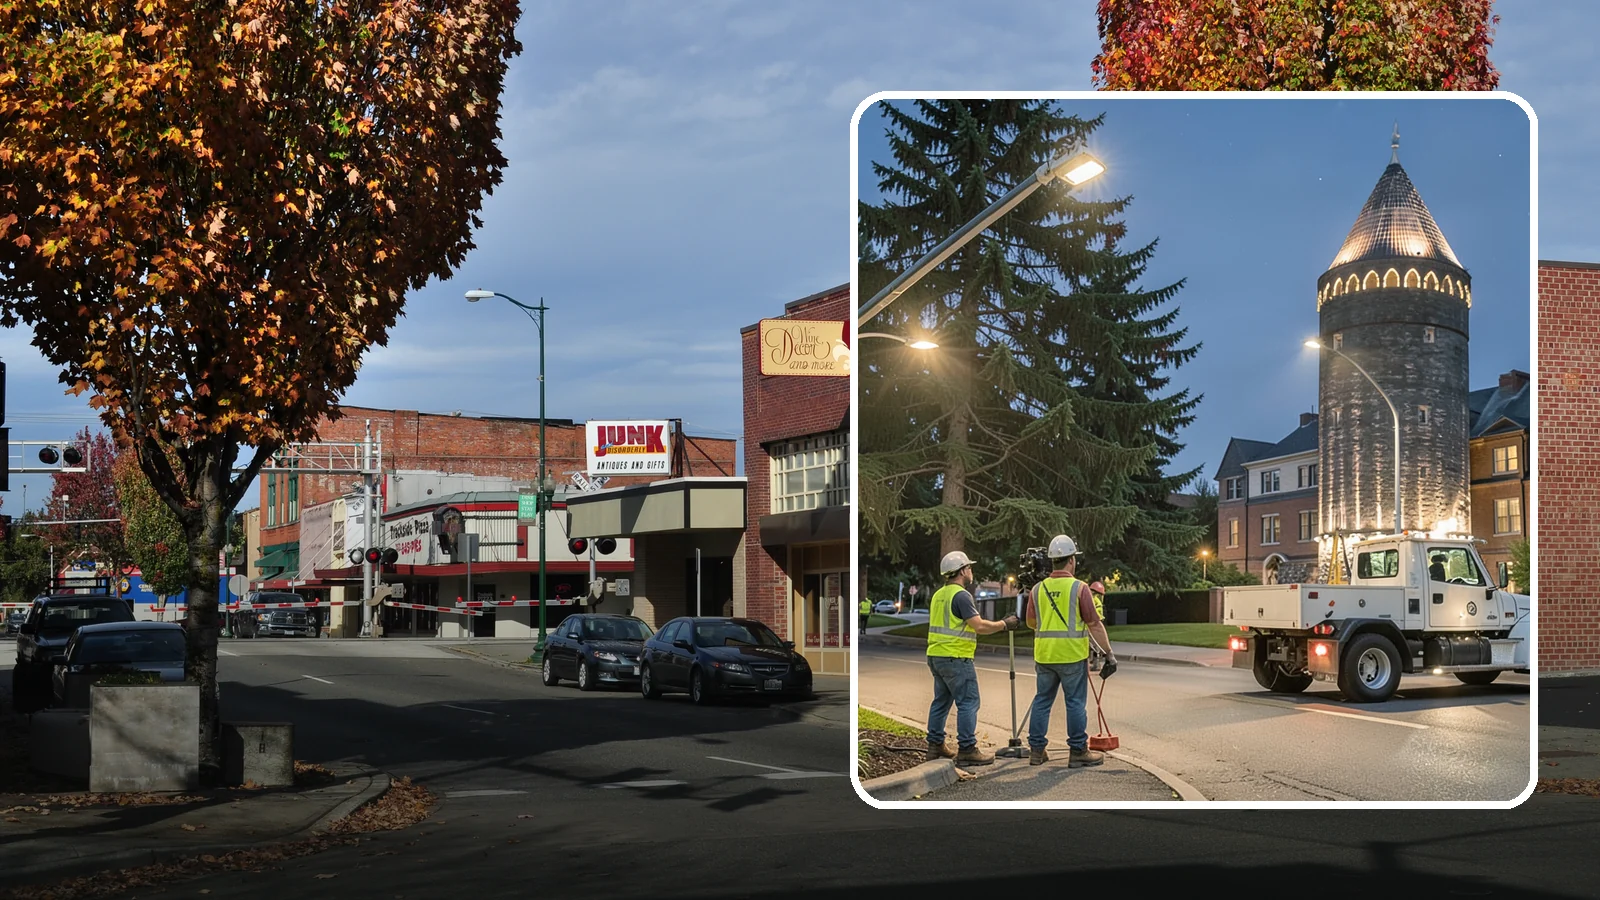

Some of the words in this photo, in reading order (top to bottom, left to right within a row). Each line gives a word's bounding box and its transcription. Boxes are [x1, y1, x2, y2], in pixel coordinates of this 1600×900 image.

[595, 425, 665, 457] JUNK
[597, 461, 628, 470] ANTIQUES
[631, 461, 643, 469] AND
[647, 460, 665, 469] GIFTS
[573, 473, 587, 490] RAIL
[352, 498, 365, 511] CRO
[414, 519, 429, 535] Pizza
